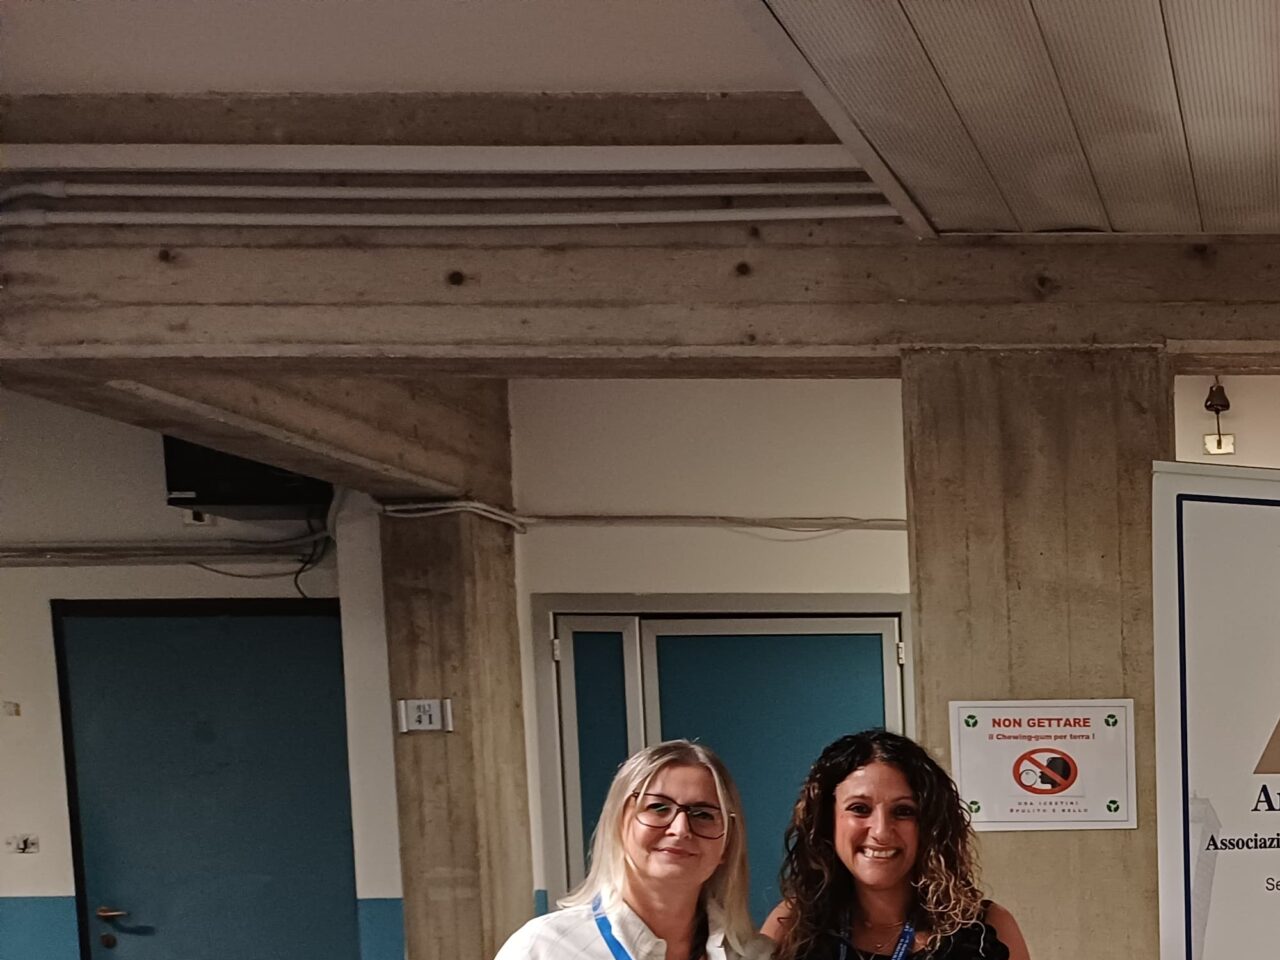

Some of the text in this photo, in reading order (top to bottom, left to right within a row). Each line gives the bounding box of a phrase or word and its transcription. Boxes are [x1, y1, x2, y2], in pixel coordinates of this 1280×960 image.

[991, 717, 1091, 728] NON GETTARE
[996, 733, 1052, 742] Chewing-gum
[1053, 734, 1067, 742] per
